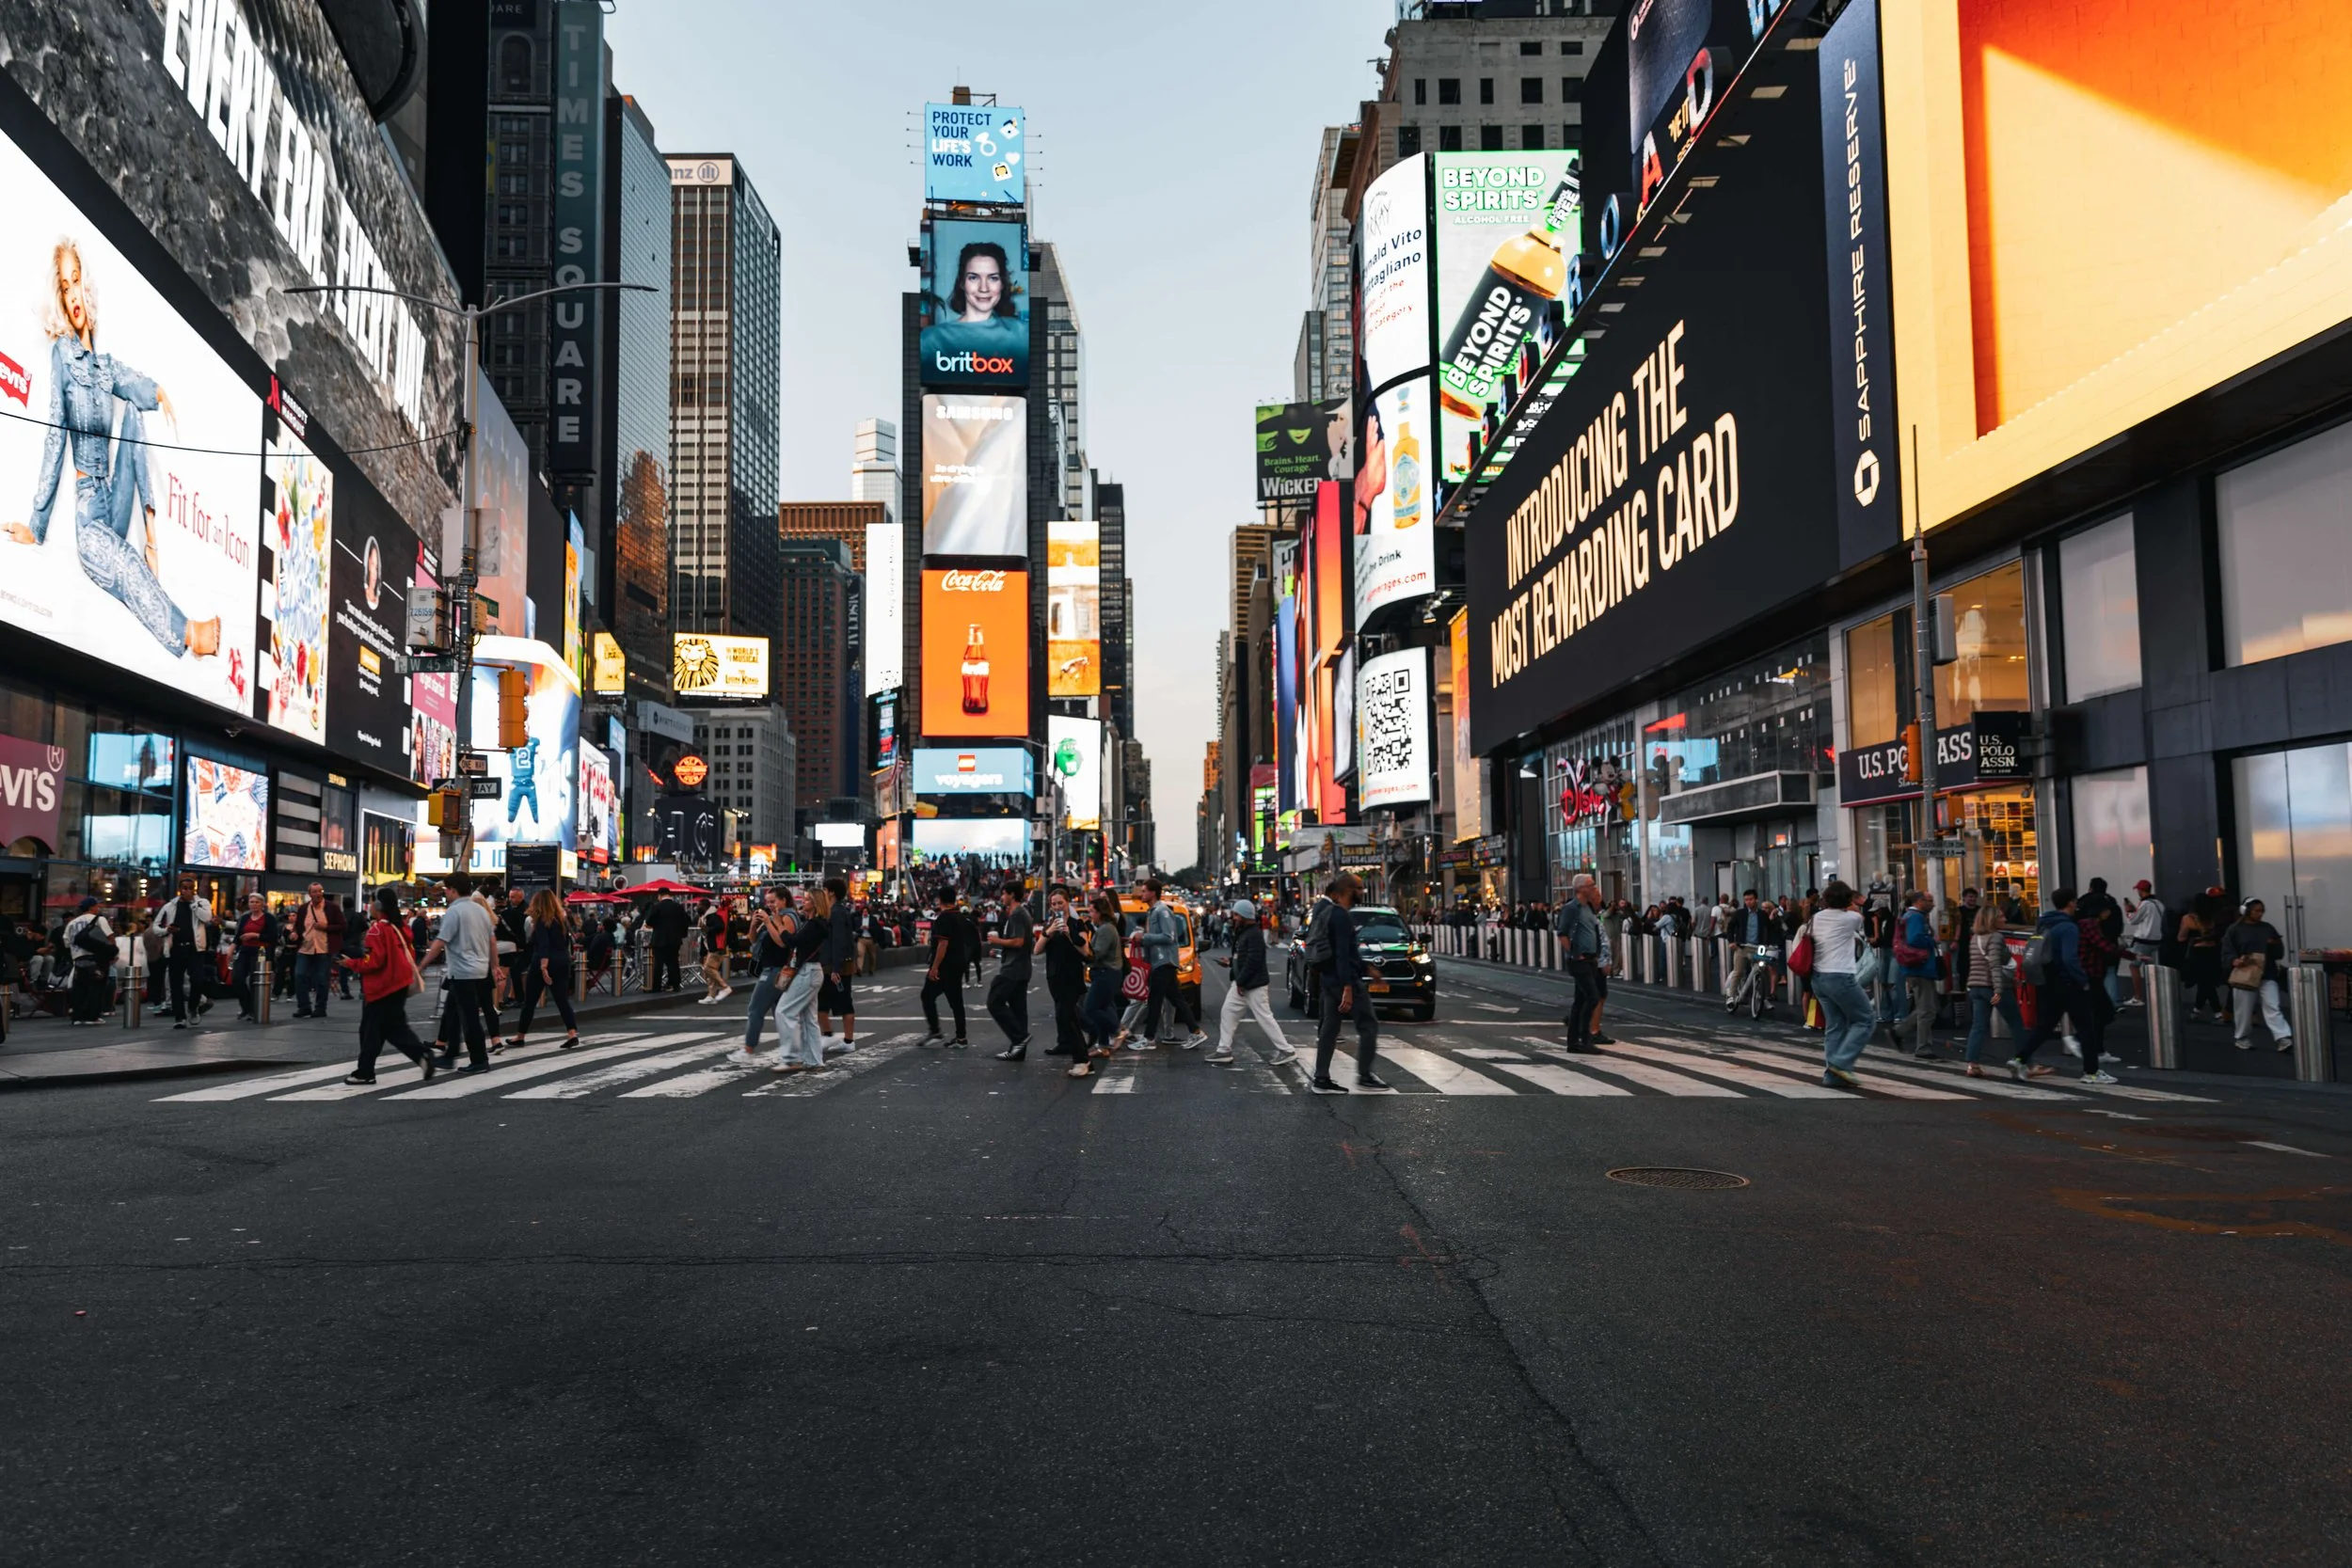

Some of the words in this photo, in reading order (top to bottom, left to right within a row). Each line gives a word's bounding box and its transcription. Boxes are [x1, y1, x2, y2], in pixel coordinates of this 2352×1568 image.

[557, 24, 589, 198] TIMES
[932, 111, 992, 126] PROTECT
[932, 125, 969, 138] YOUR
[931, 138, 971, 153] LIFE'S
[932, 153, 973, 167] WORK
[1443, 166, 1546, 188] BEYOND
[1444, 189, 1539, 211] SPIRITS
[1553, 192, 1580, 229] FREE
[1454, 215, 1502, 224] ALCOHOL
[1504, 214, 1531, 224] FREE
[1391, 229, 1422, 249] Vito
[554, 227, 585, 442] SQUARE
[1446, 287, 1511, 389] BEYOND
[1853, 243, 1872, 442] SAPPHIRE
[1468, 305, 1532, 397] SPIRITS
[936, 351, 1013, 373] britbox
[1295, 454, 1322, 464] Heart.
[1505, 390, 1629, 591] INTRODUCING
[1632, 318, 1688, 466] THE
[1274, 465, 1311, 474] Courage.
[168, 472, 188, 529] Fit
[193, 491, 213, 544] for
[225, 514, 249, 569] Icon
[1378, 549, 1403, 567] Drink
[1491, 591, 1530, 689] MOST
[1532, 488, 1650, 660] REWARDING
[1657, 411, 1740, 571] CARD
[941, 569, 1007, 592] Coca-Cola
[410, 658, 421, 671] W
[426, 658, 441, 671] 45
[1937, 732, 1972, 766] ASS
[1979, 735, 2003, 746] U.S.
[1979, 746, 2015, 756] POLO
[462, 760, 472, 768] ONE
[475, 760, 485, 768] WAY
[1858, 751, 1884, 779] U.S.
[1979, 757, 2019, 768] ASSN.
[0, 764, 56, 813] VI'S
[328, 773, 347, 787] SEPHORA
[472, 784, 493, 793] WAY
[934, 773, 1004, 789] voyagers
[324, 851, 357, 873] SEPHORA
